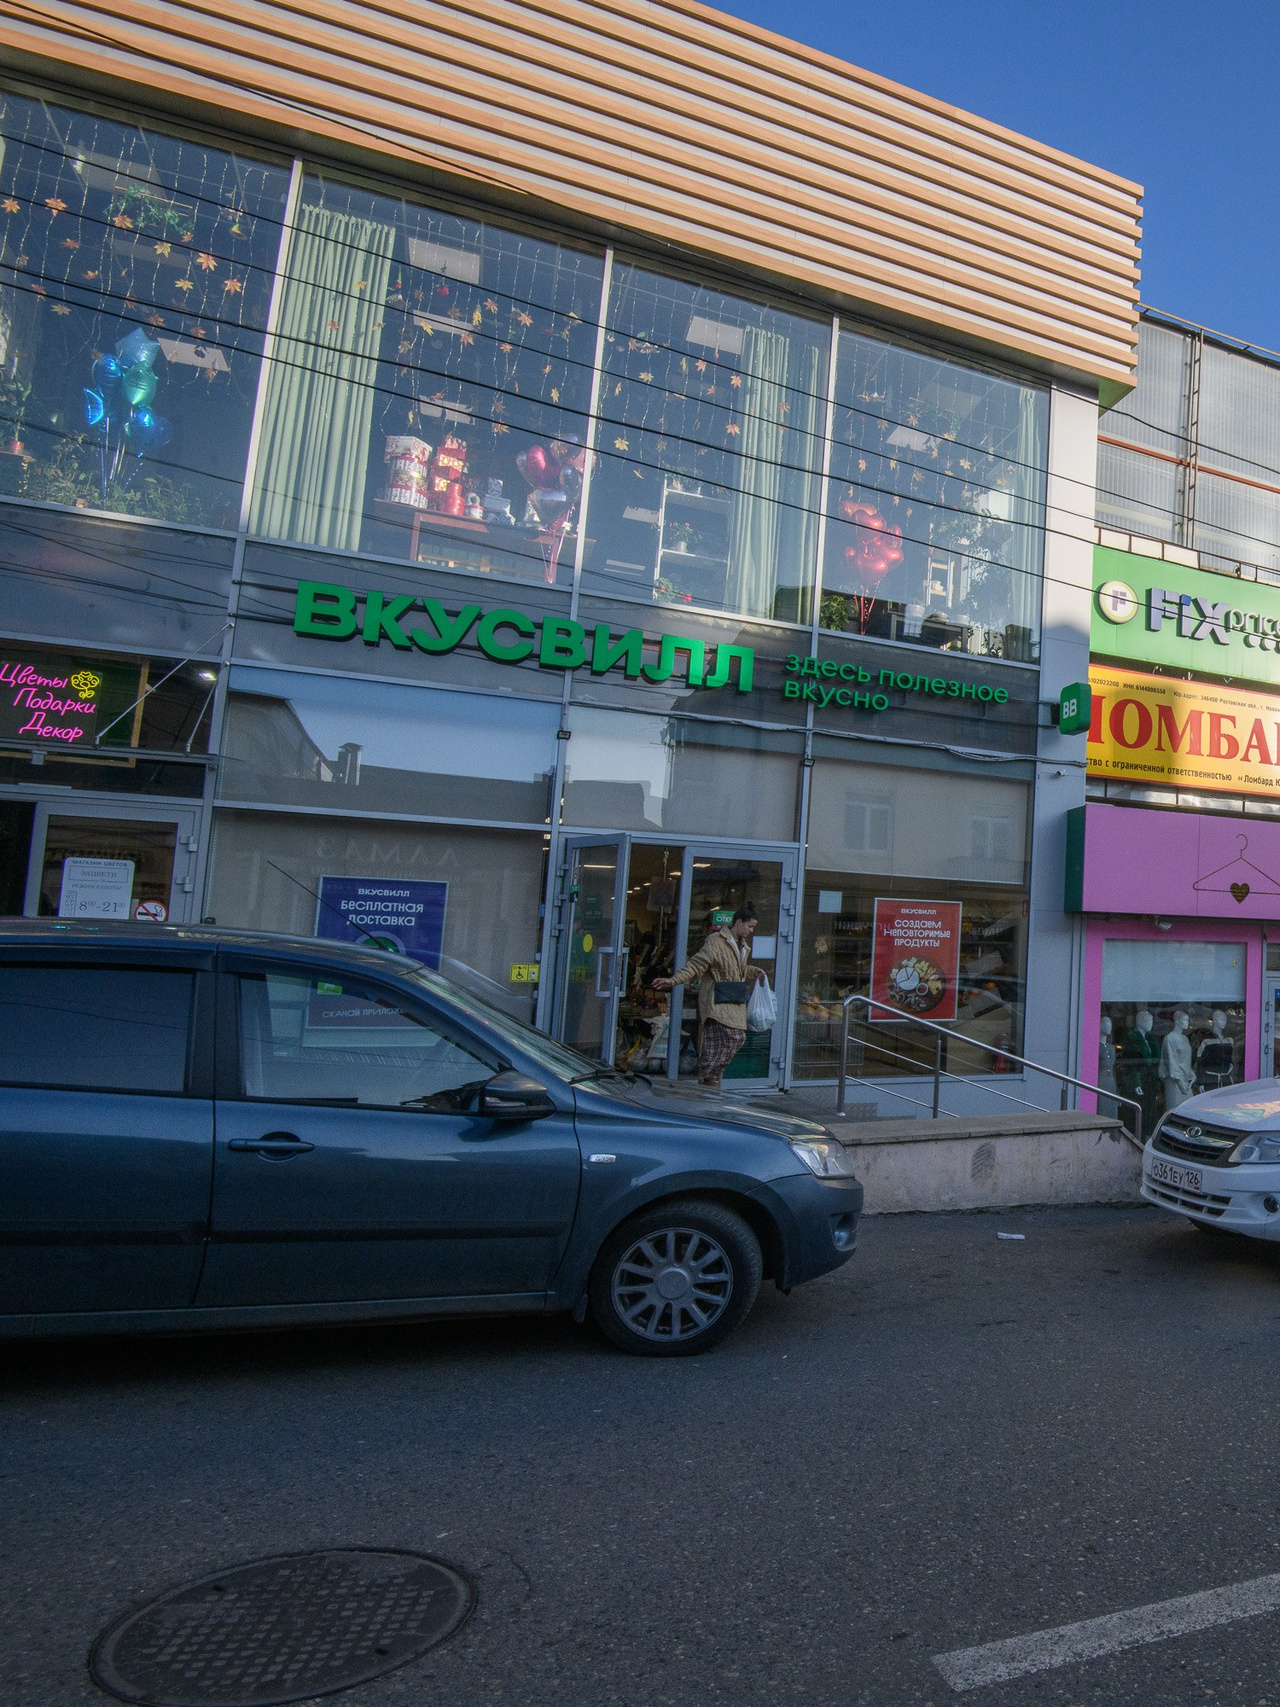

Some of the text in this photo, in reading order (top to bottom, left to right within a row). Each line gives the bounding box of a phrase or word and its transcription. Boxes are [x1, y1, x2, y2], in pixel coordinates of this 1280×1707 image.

[293, 579, 756, 694] ВКУСВИЛЛ
[0, 663, 69, 688] Цветы
[783, 653, 1010, 705] здесь полезное
[1122, 682, 1135, 690] ИНН
[13, 687, 97, 716] Подарки
[783, 679, 890, 712] вкусно
[18, 711, 84, 743] Декор
[1112, 760, 1165, 774] ограниченной
[1167, 766, 1232, 781] ответственностью
[357, 887, 410, 897] ВКУСВИЛЛ
[894, 938, 940, 948] ПРОДУКТЫ
[1185, 1170, 1201, 1186] 126
